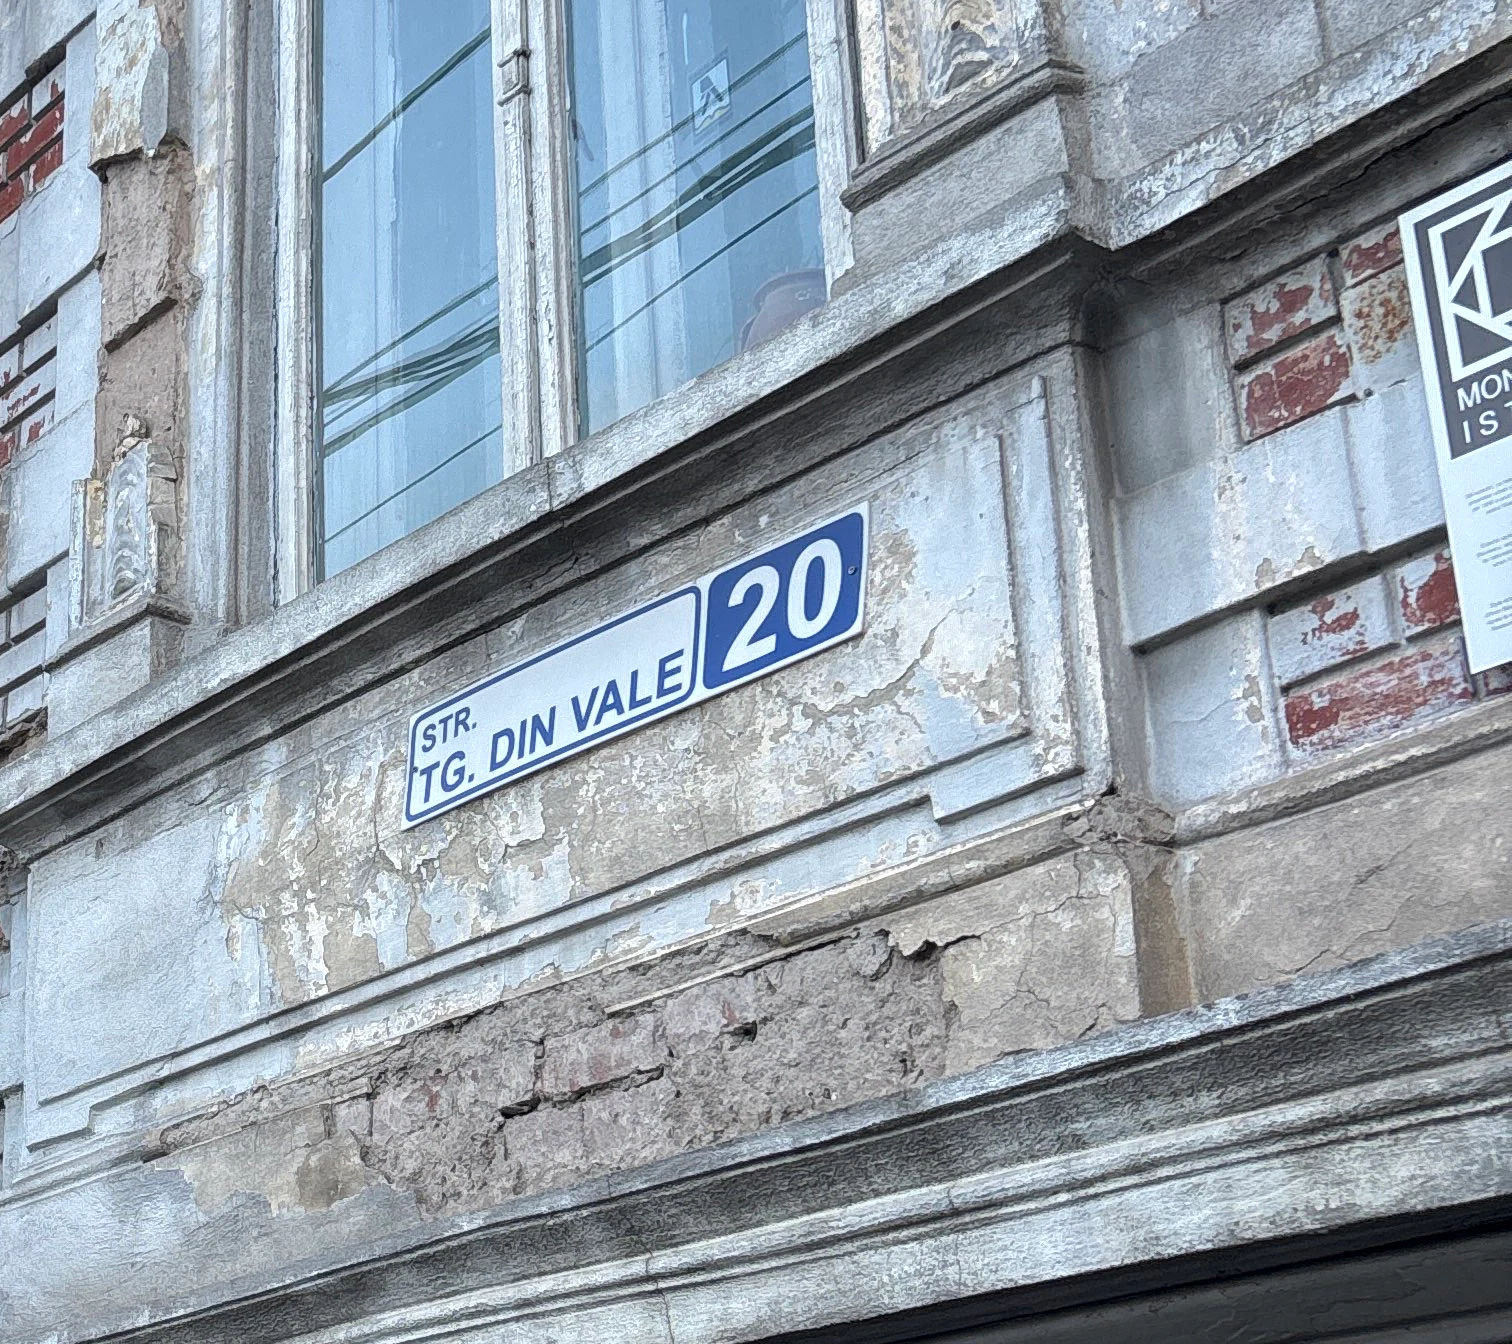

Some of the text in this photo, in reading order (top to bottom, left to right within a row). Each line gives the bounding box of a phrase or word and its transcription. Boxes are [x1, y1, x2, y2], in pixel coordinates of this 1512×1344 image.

[722, 538, 844, 673] 20
[419, 648, 685, 804] TG. DIN VALE
[421, 706, 478, 753] STR.
